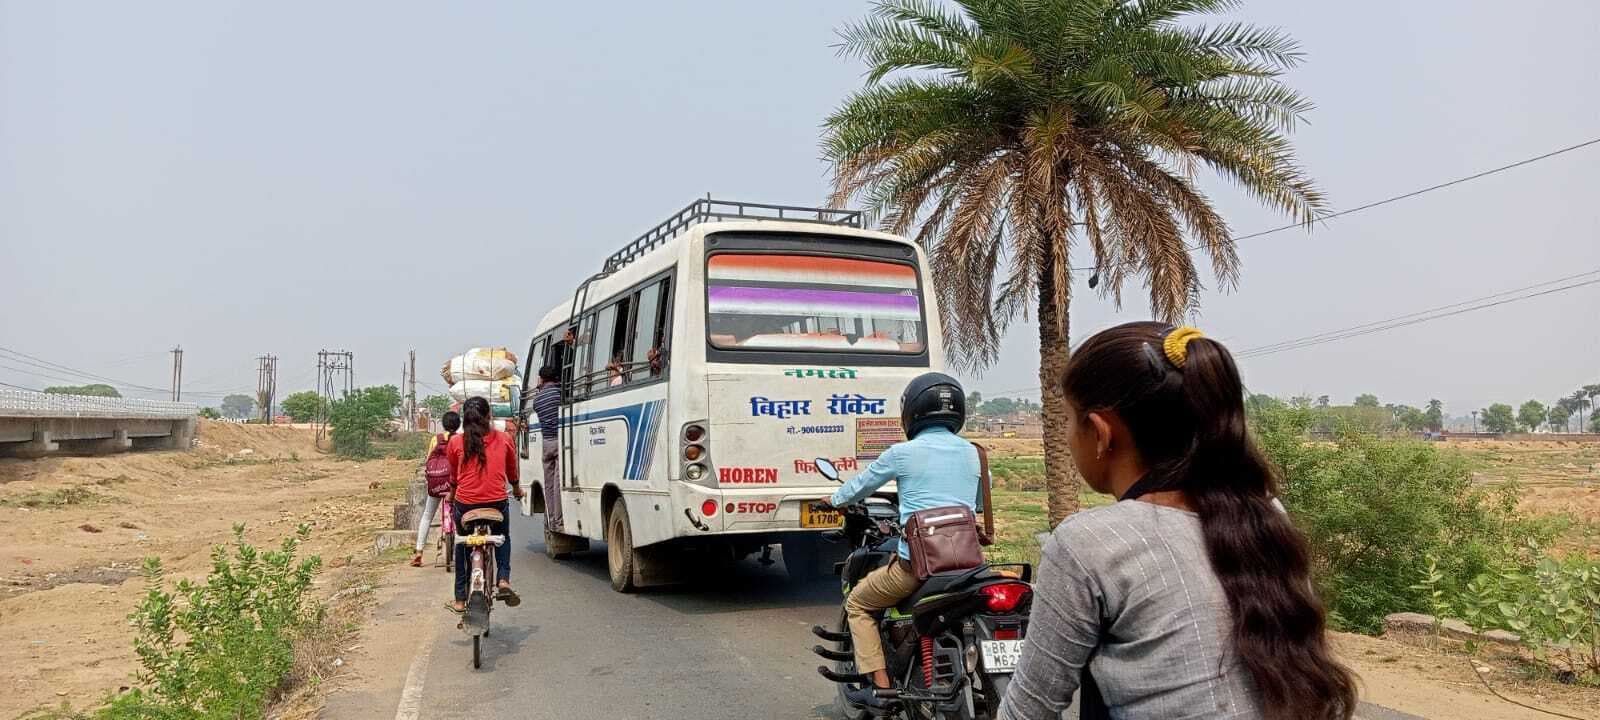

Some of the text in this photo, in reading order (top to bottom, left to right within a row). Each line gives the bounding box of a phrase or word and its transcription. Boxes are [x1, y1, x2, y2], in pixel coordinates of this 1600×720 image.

[784, 368, 858, 379] नमस्ते
[749, 393, 887, 419] बिहार रॉकेट
[719, 468, 778, 484] HOREN
[737, 502, 777, 514] STOP
[991, 642, 1007, 654] BR
[993, 654, 1021, 667] M62
